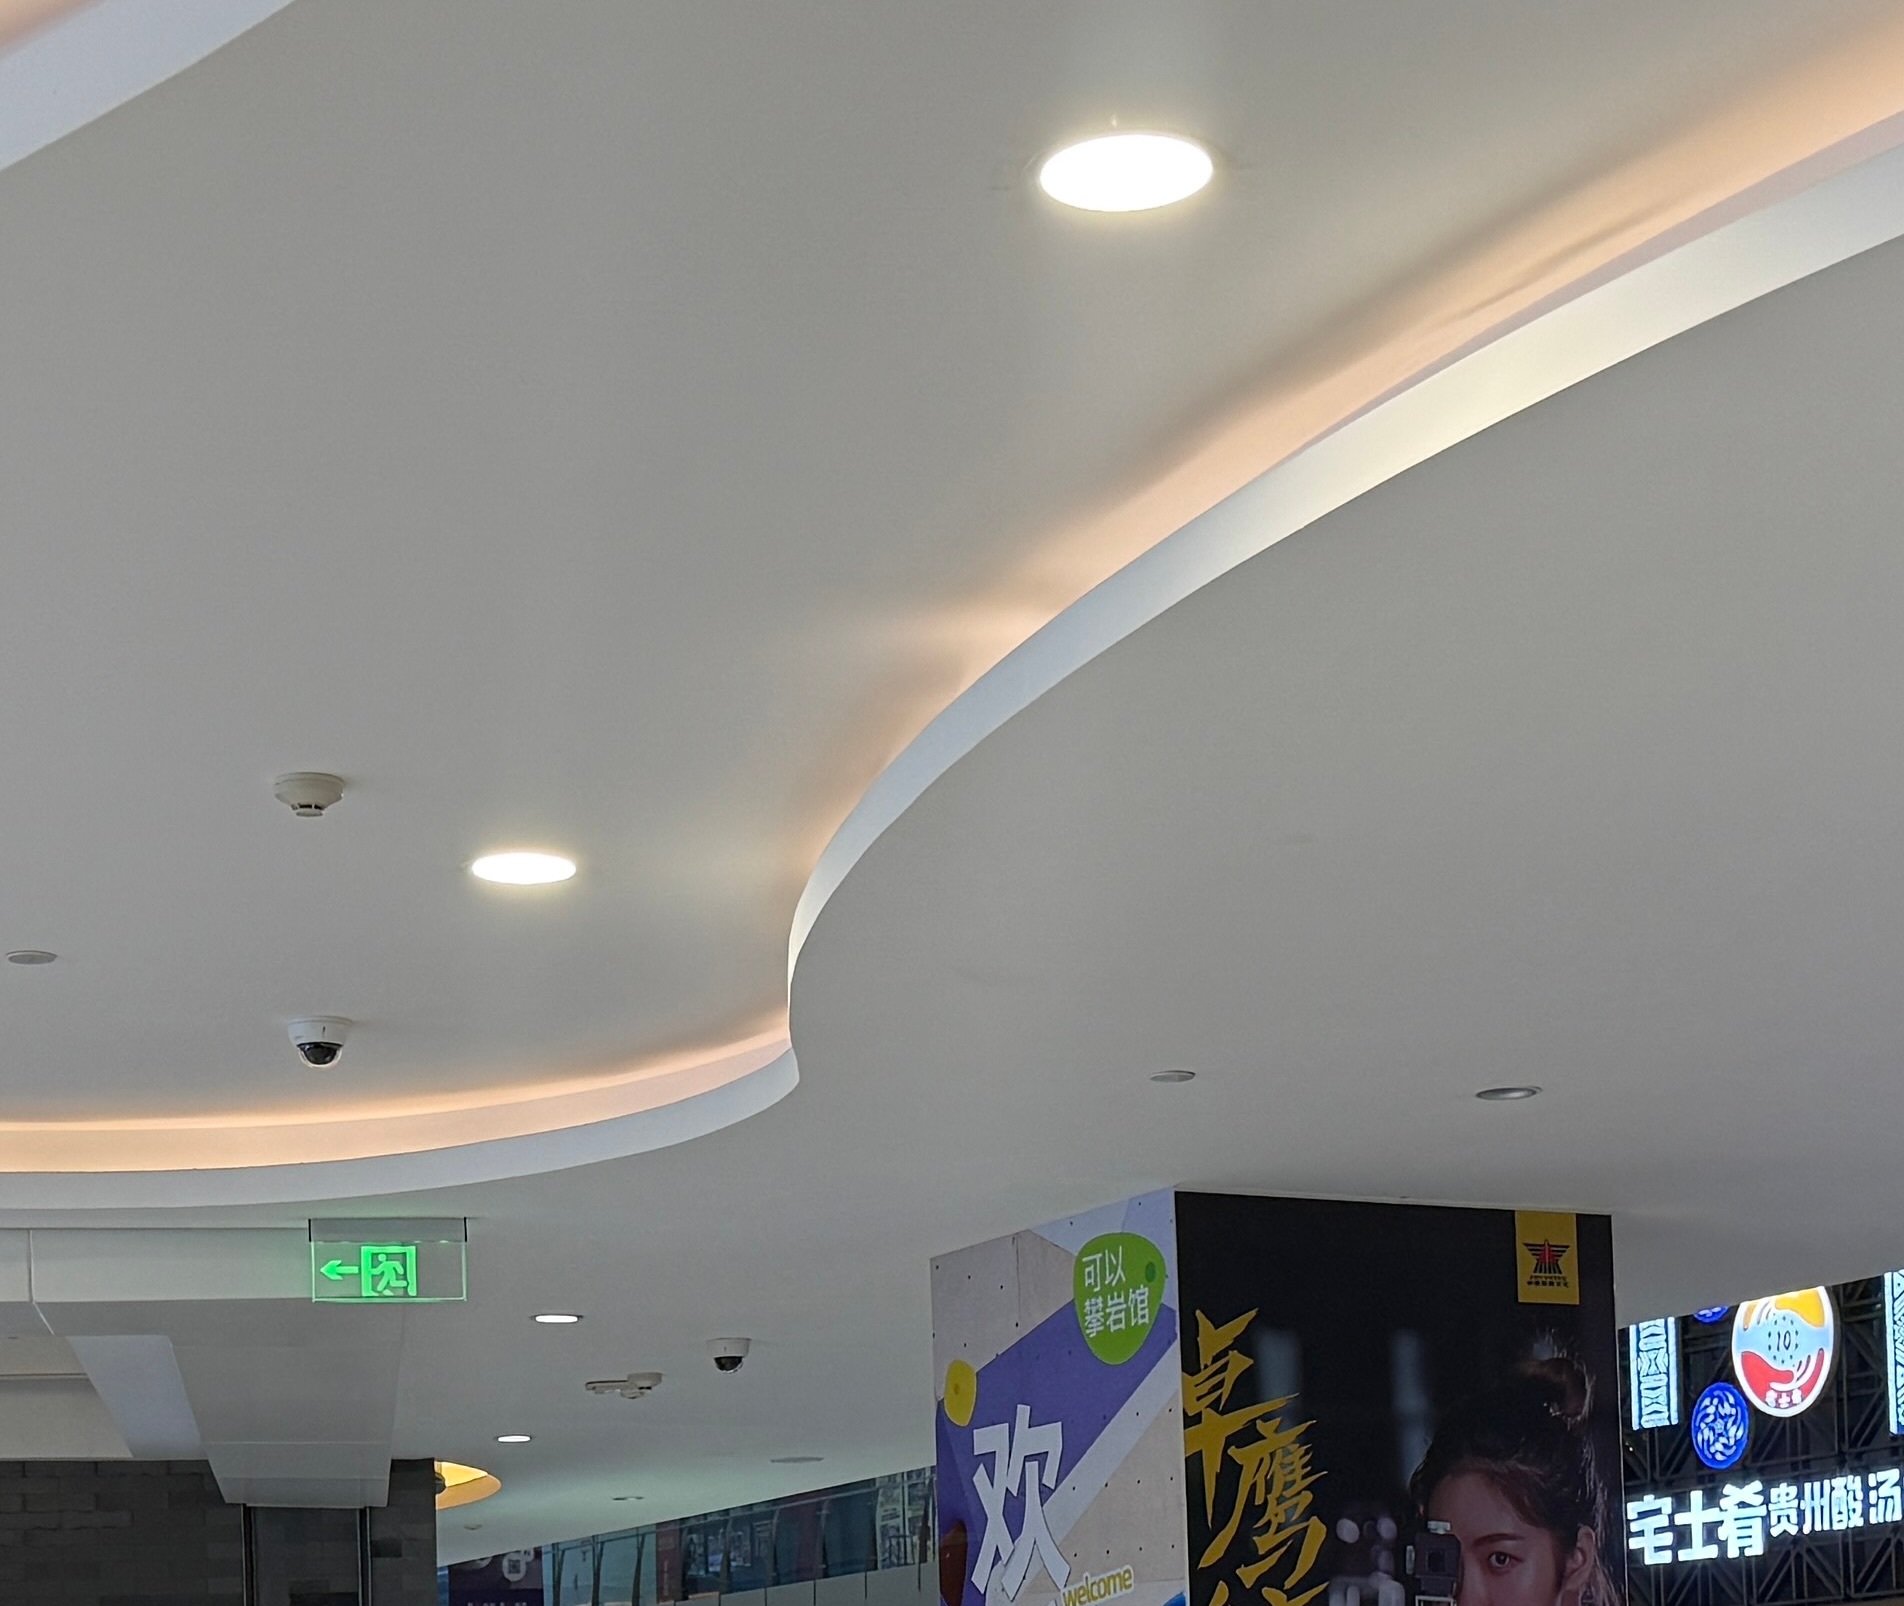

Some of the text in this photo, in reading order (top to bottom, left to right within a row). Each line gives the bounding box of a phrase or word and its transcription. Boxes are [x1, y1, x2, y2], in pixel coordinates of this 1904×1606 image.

[1082, 1245, 1127, 1290] 可以
[1083, 1284, 1150, 1339] 攀岩馆
